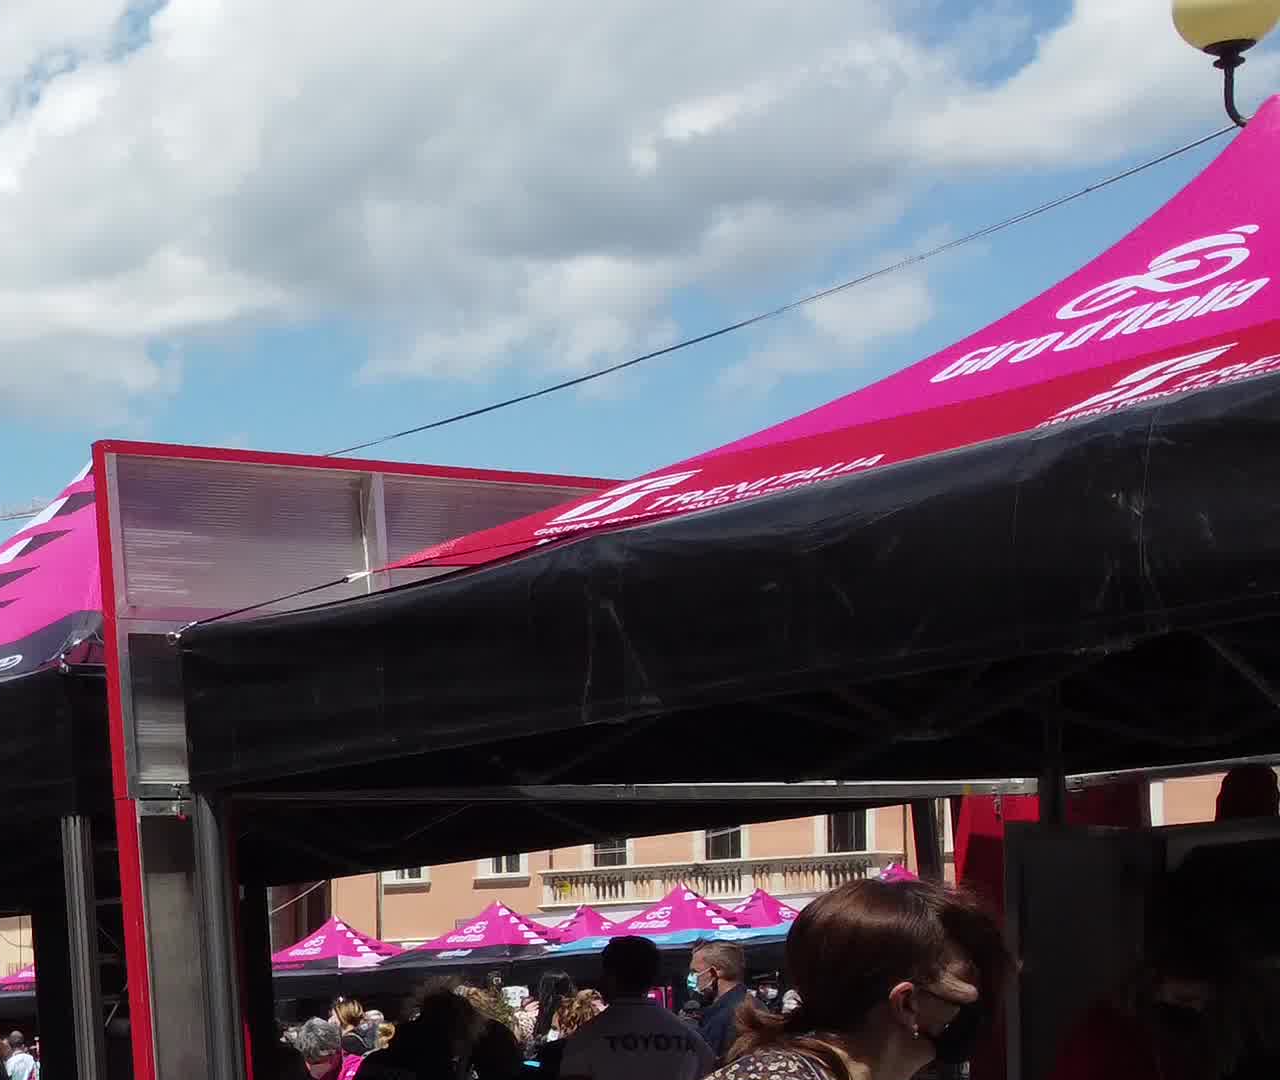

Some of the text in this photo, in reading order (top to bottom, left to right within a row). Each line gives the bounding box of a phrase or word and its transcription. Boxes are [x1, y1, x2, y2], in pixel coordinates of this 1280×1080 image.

[929, 332, 1065, 383] Giro
[645, 454, 886, 511] TRENITALIA
[601, 1032, 696, 1053] TOYOTA
